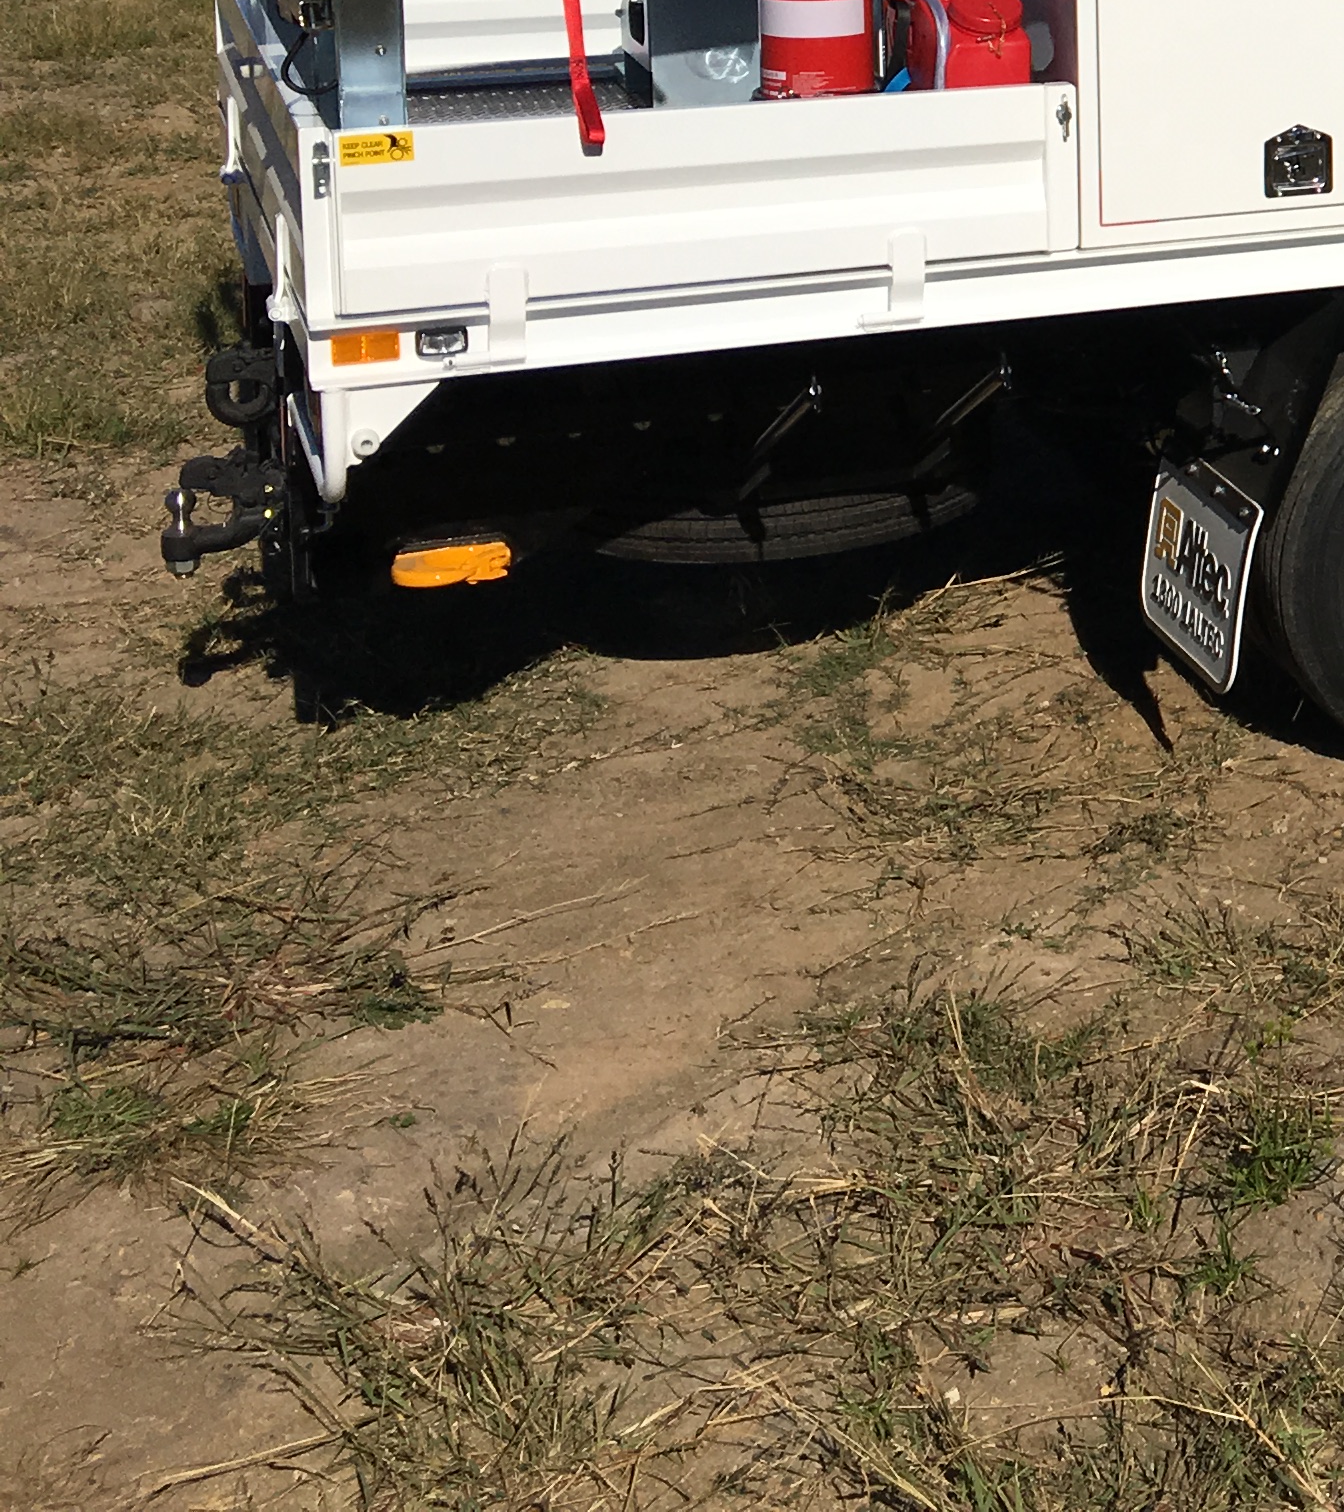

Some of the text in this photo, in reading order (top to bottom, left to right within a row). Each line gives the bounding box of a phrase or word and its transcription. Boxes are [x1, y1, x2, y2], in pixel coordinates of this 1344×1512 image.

[361, 140, 384, 149] CLEAR
[365, 149, 385, 158] POINT
[1150, 573, 1183, 620] 1300
